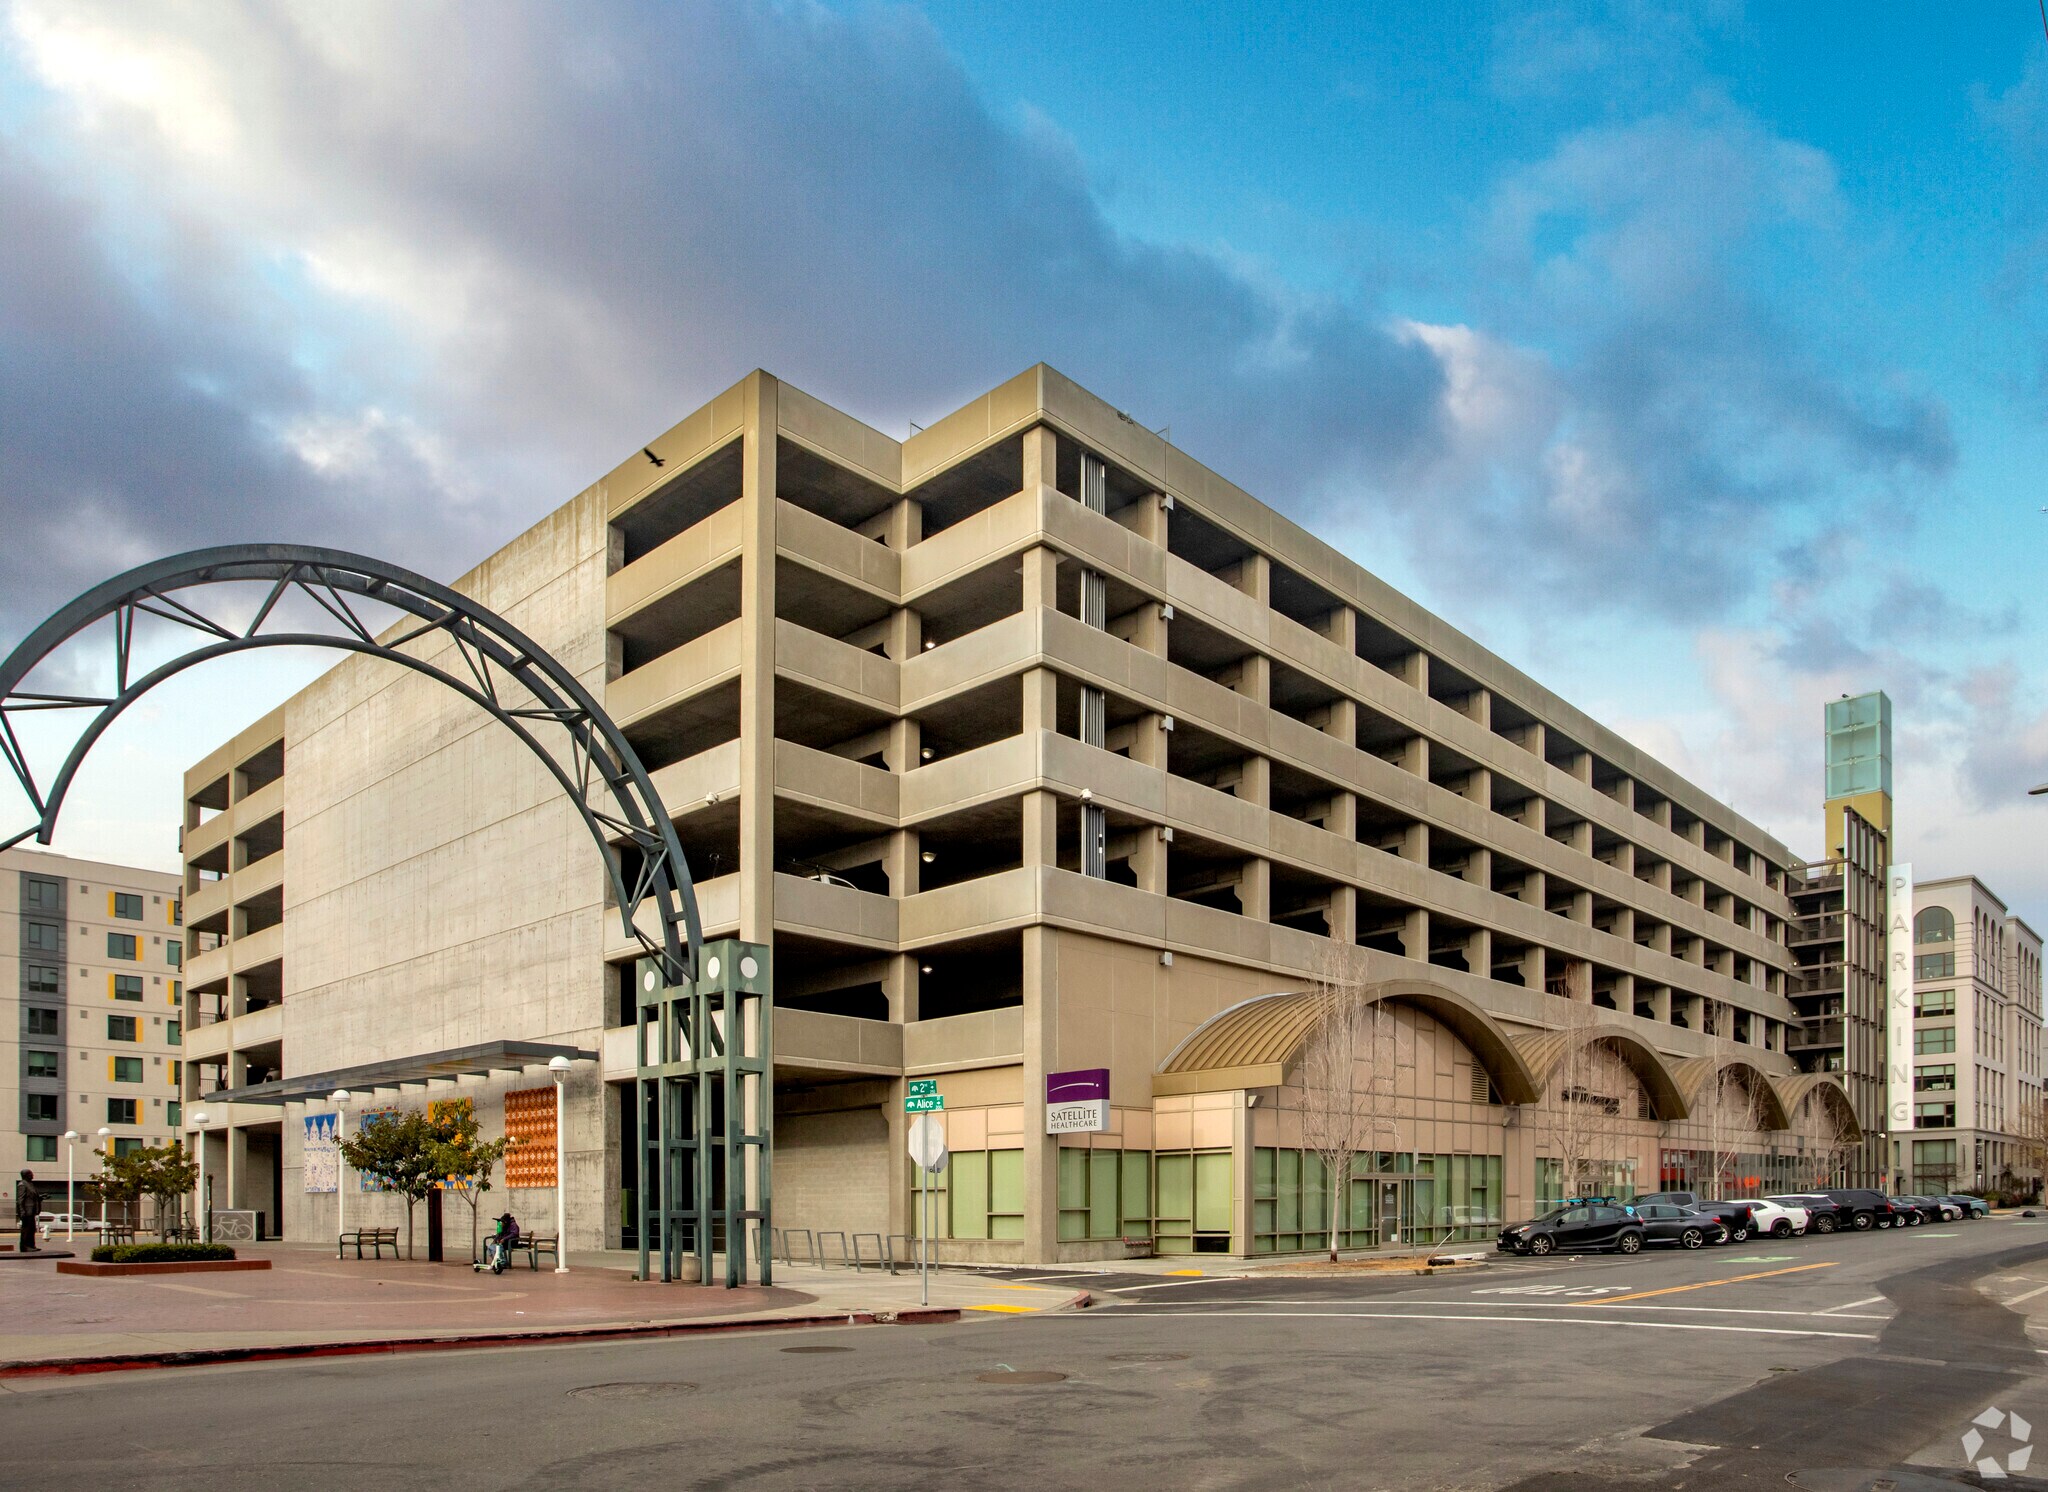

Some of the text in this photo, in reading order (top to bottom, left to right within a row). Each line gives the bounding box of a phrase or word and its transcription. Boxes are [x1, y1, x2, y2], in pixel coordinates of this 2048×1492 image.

[1889, 876, 1909, 1122] PARKING
[916, 1098, 934, 1109] Alice
[1051, 1108, 1097, 1122] SATELLITE
[1051, 1119, 1097, 1129] HEALTHCARE
